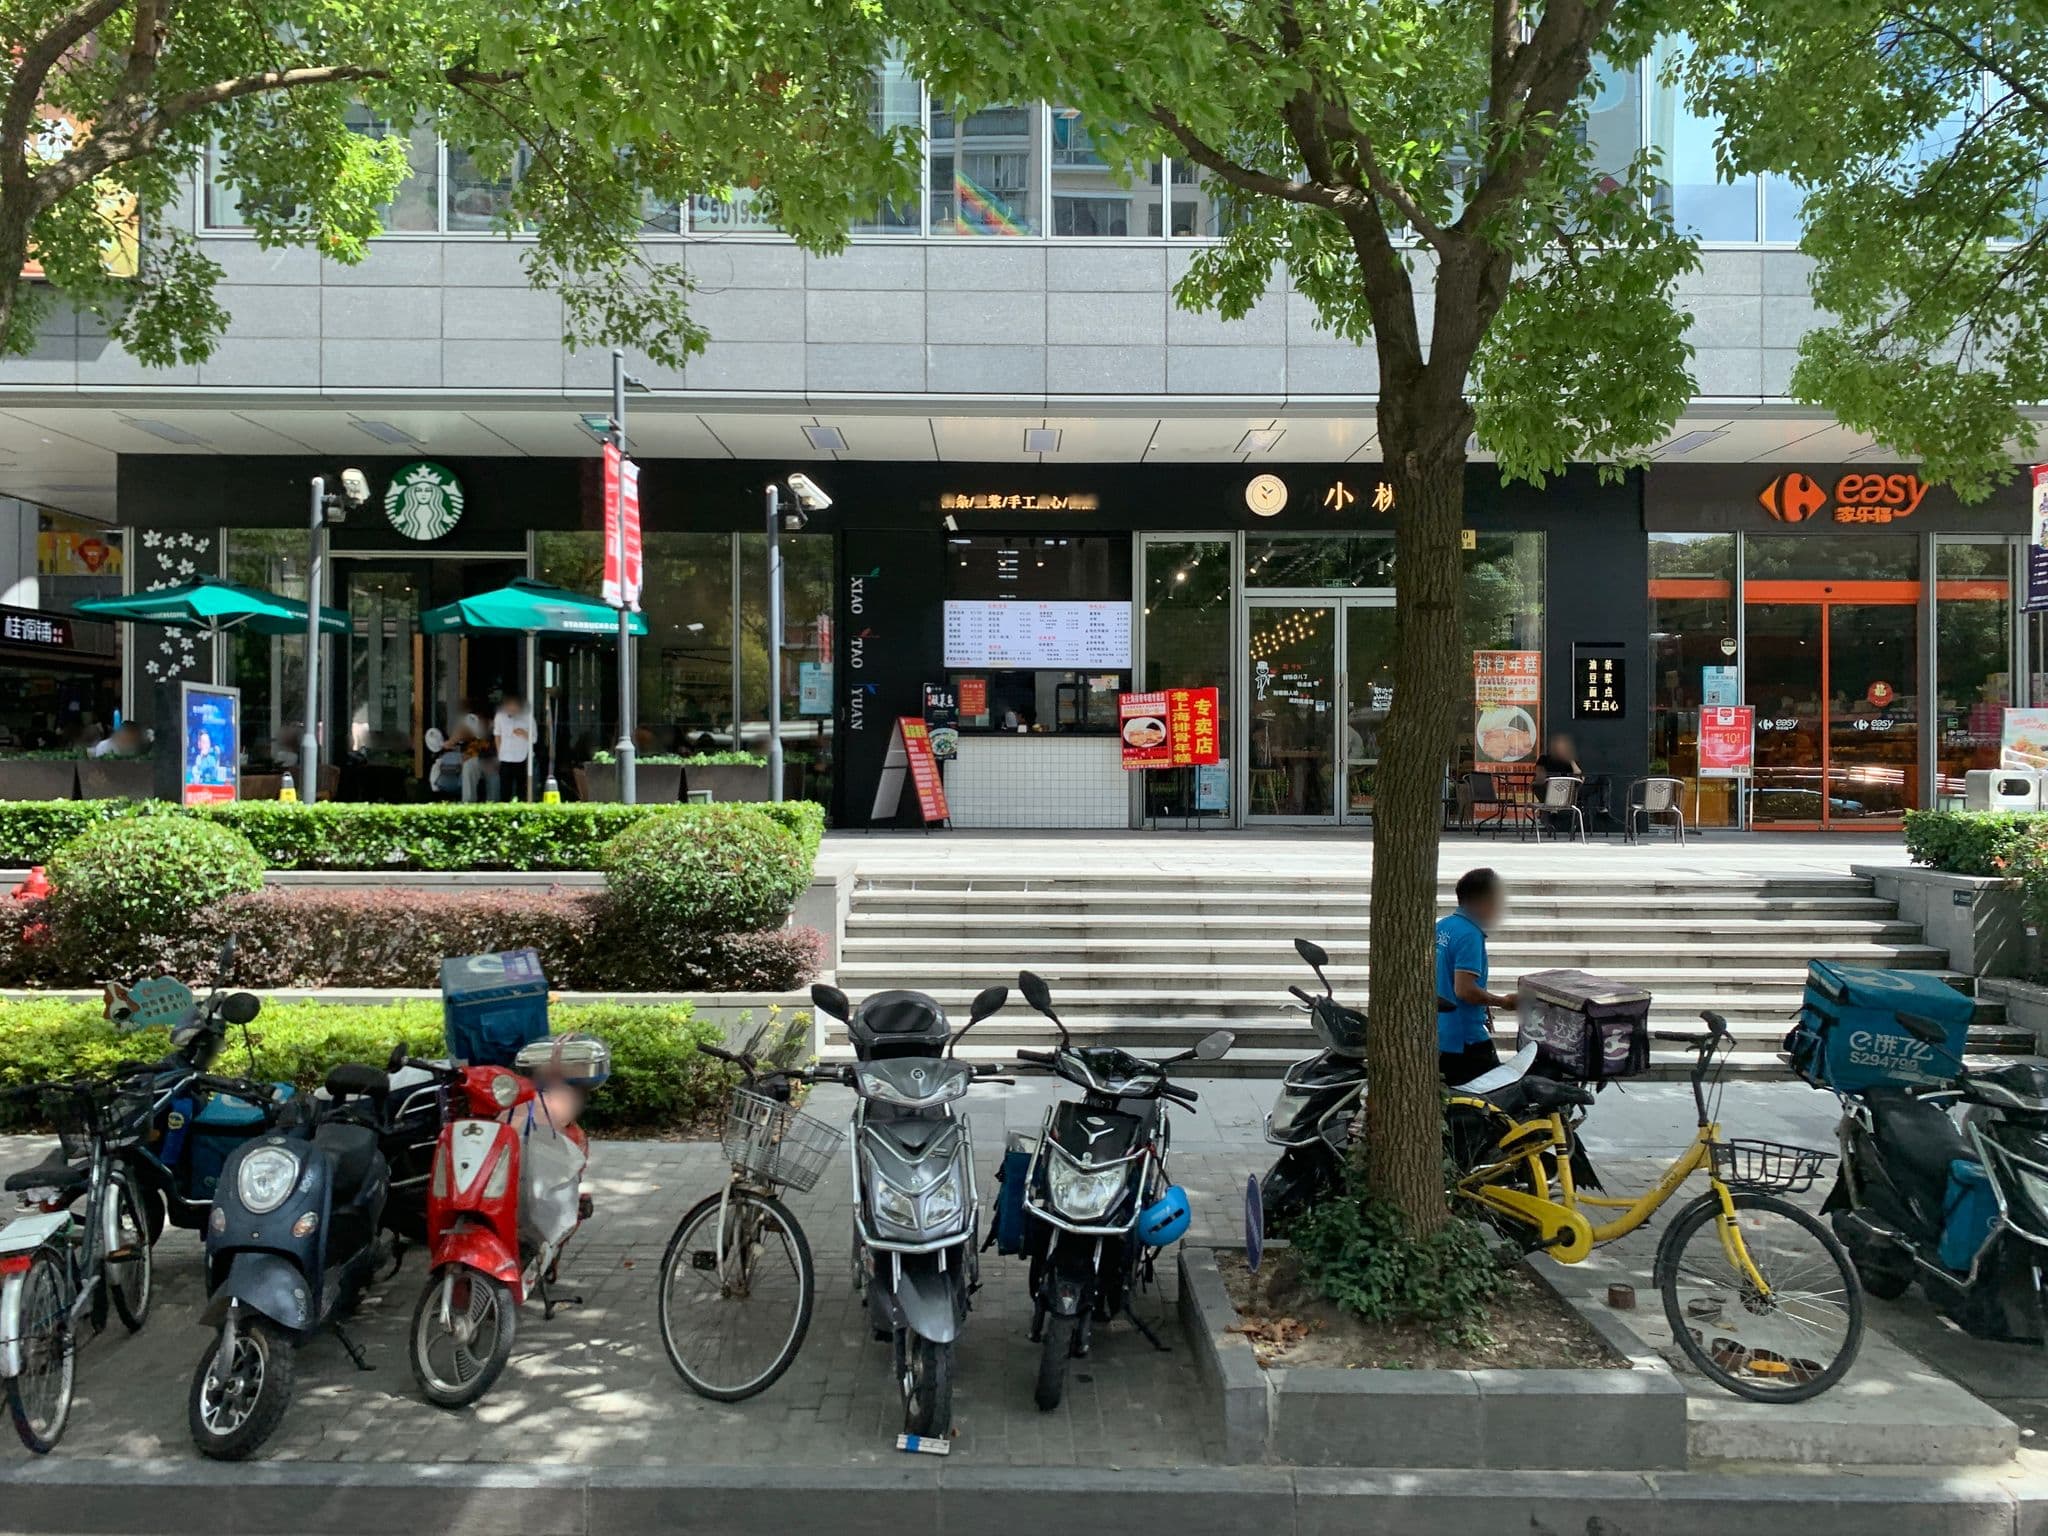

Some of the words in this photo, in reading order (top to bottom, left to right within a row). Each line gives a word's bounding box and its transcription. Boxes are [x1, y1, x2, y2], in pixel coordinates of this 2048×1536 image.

[1837, 473, 1930, 517] easy
[1836, 506, 1893, 524] 家乐福
[851, 577, 863, 615] XIAO
[4, 615, 52, 643] 桂源铺
[851, 637, 863, 669] TAO
[851, 687, 863, 731] YUAN
[1583, 699, 1619, 711] 手工点心
[1172, 691, 1192, 764] 老上海排骨年糕
[1194, 698, 1213, 755] 专卖店
[1775, 718, 1799, 730] easy
[1870, 718, 1894, 730] easy
[1874, 1033, 1934, 1061] 饿了么
[1849, 1051, 1919, 1072] S294799
